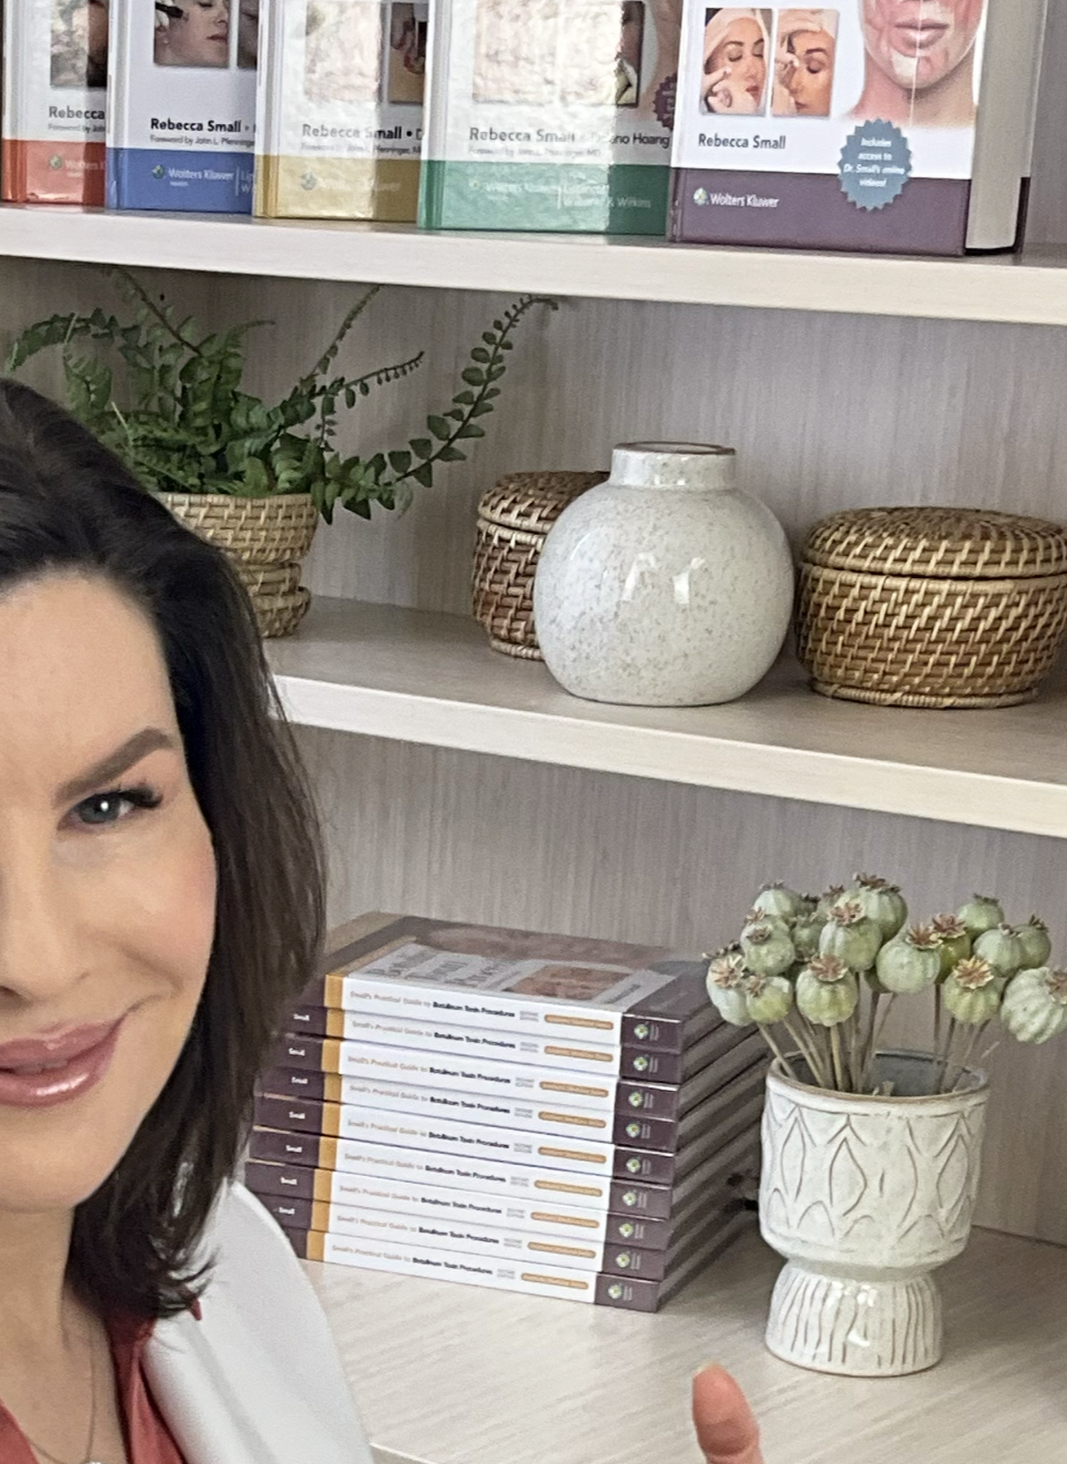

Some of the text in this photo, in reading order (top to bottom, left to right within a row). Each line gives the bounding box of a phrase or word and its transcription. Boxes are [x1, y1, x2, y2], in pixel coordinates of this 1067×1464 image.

[48, 105, 105, 120] Rebecca
[150, 118, 241, 132] Rebecca Small
[302, 124, 402, 139] Rebecca Small
[470, 127, 531, 142] Rebecca
[536, 128, 576, 142] Small
[632, 132, 670, 150] Hoang
[698, 133, 786, 149] Rebecca Small
[710, 192, 780, 208] Wolters Kluwer
